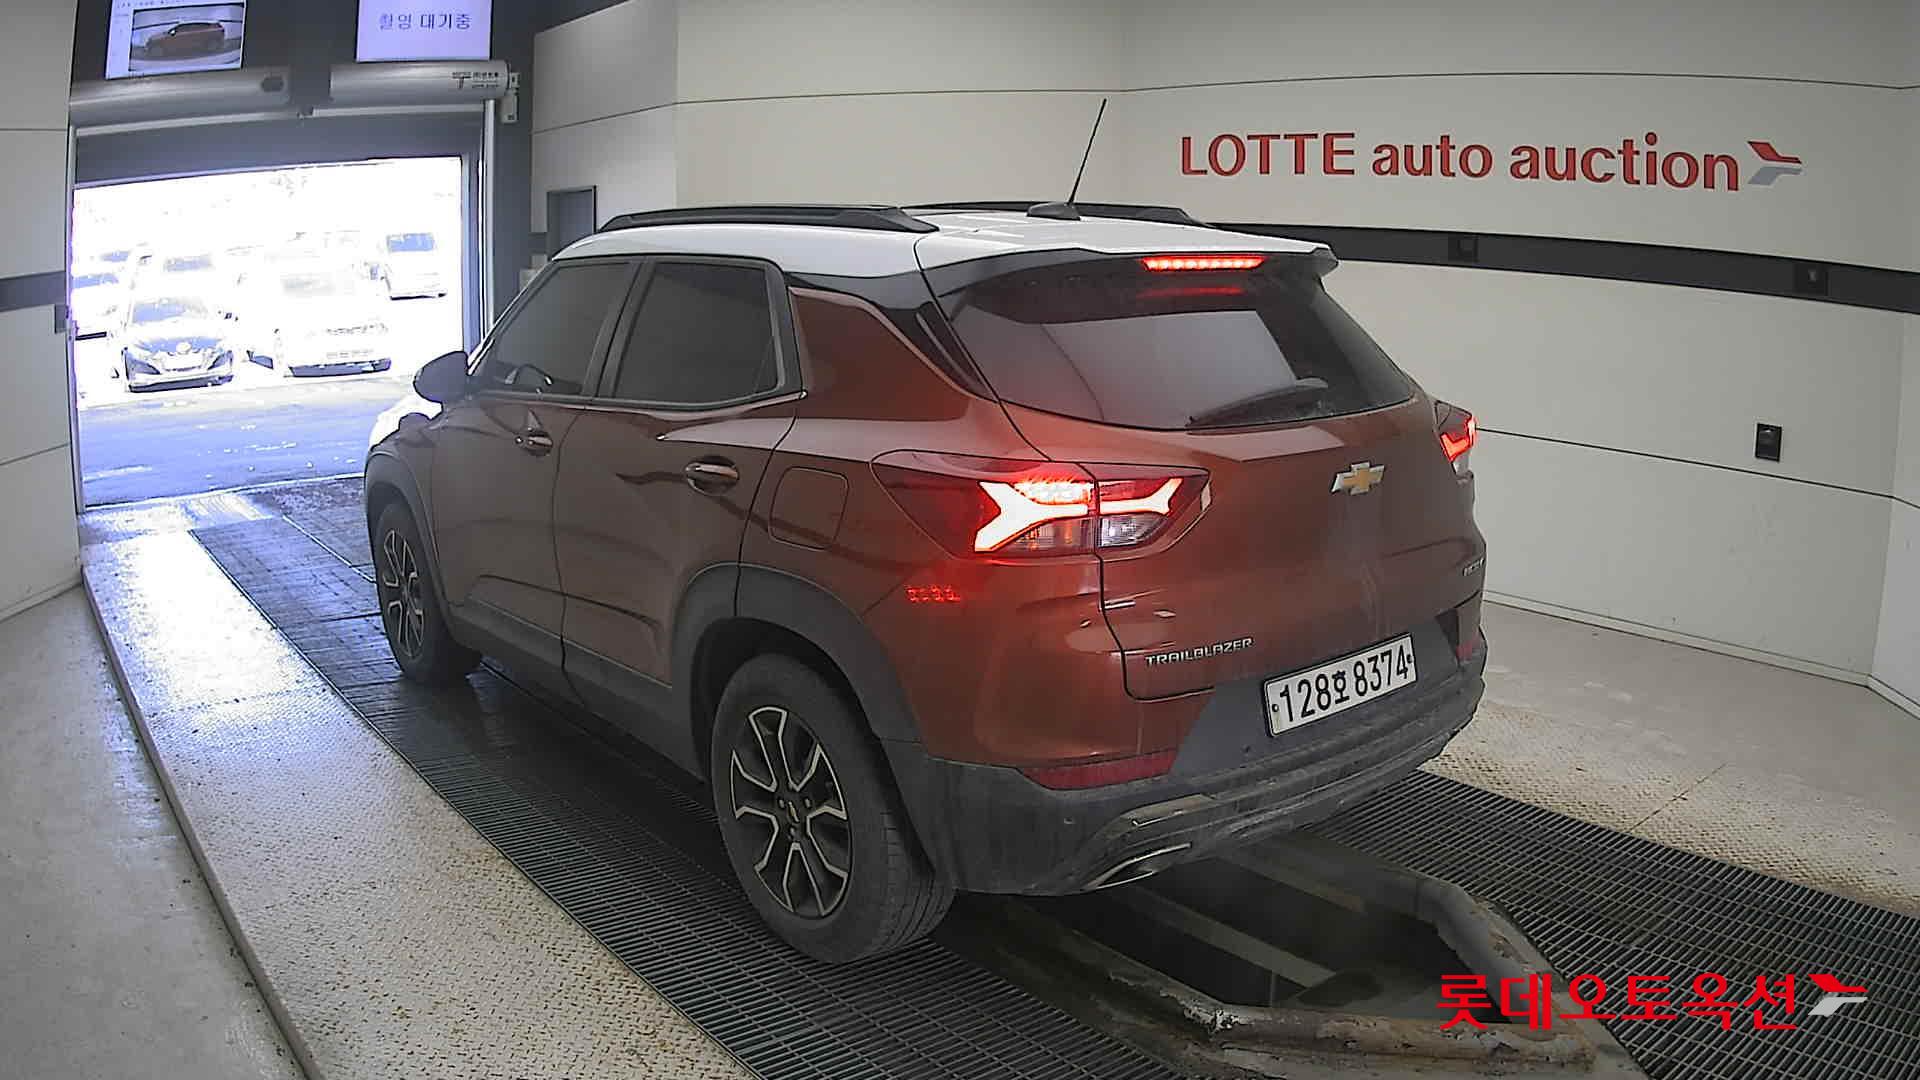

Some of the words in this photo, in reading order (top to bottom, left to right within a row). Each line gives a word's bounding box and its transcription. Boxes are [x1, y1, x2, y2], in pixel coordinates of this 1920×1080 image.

[1181, 131, 1355, 176] LOTTE
[1372, 134, 1493, 177] auto
[1509, 131, 1740, 191] auction
[1144, 637, 1254, 667] TRAILBLAZER
